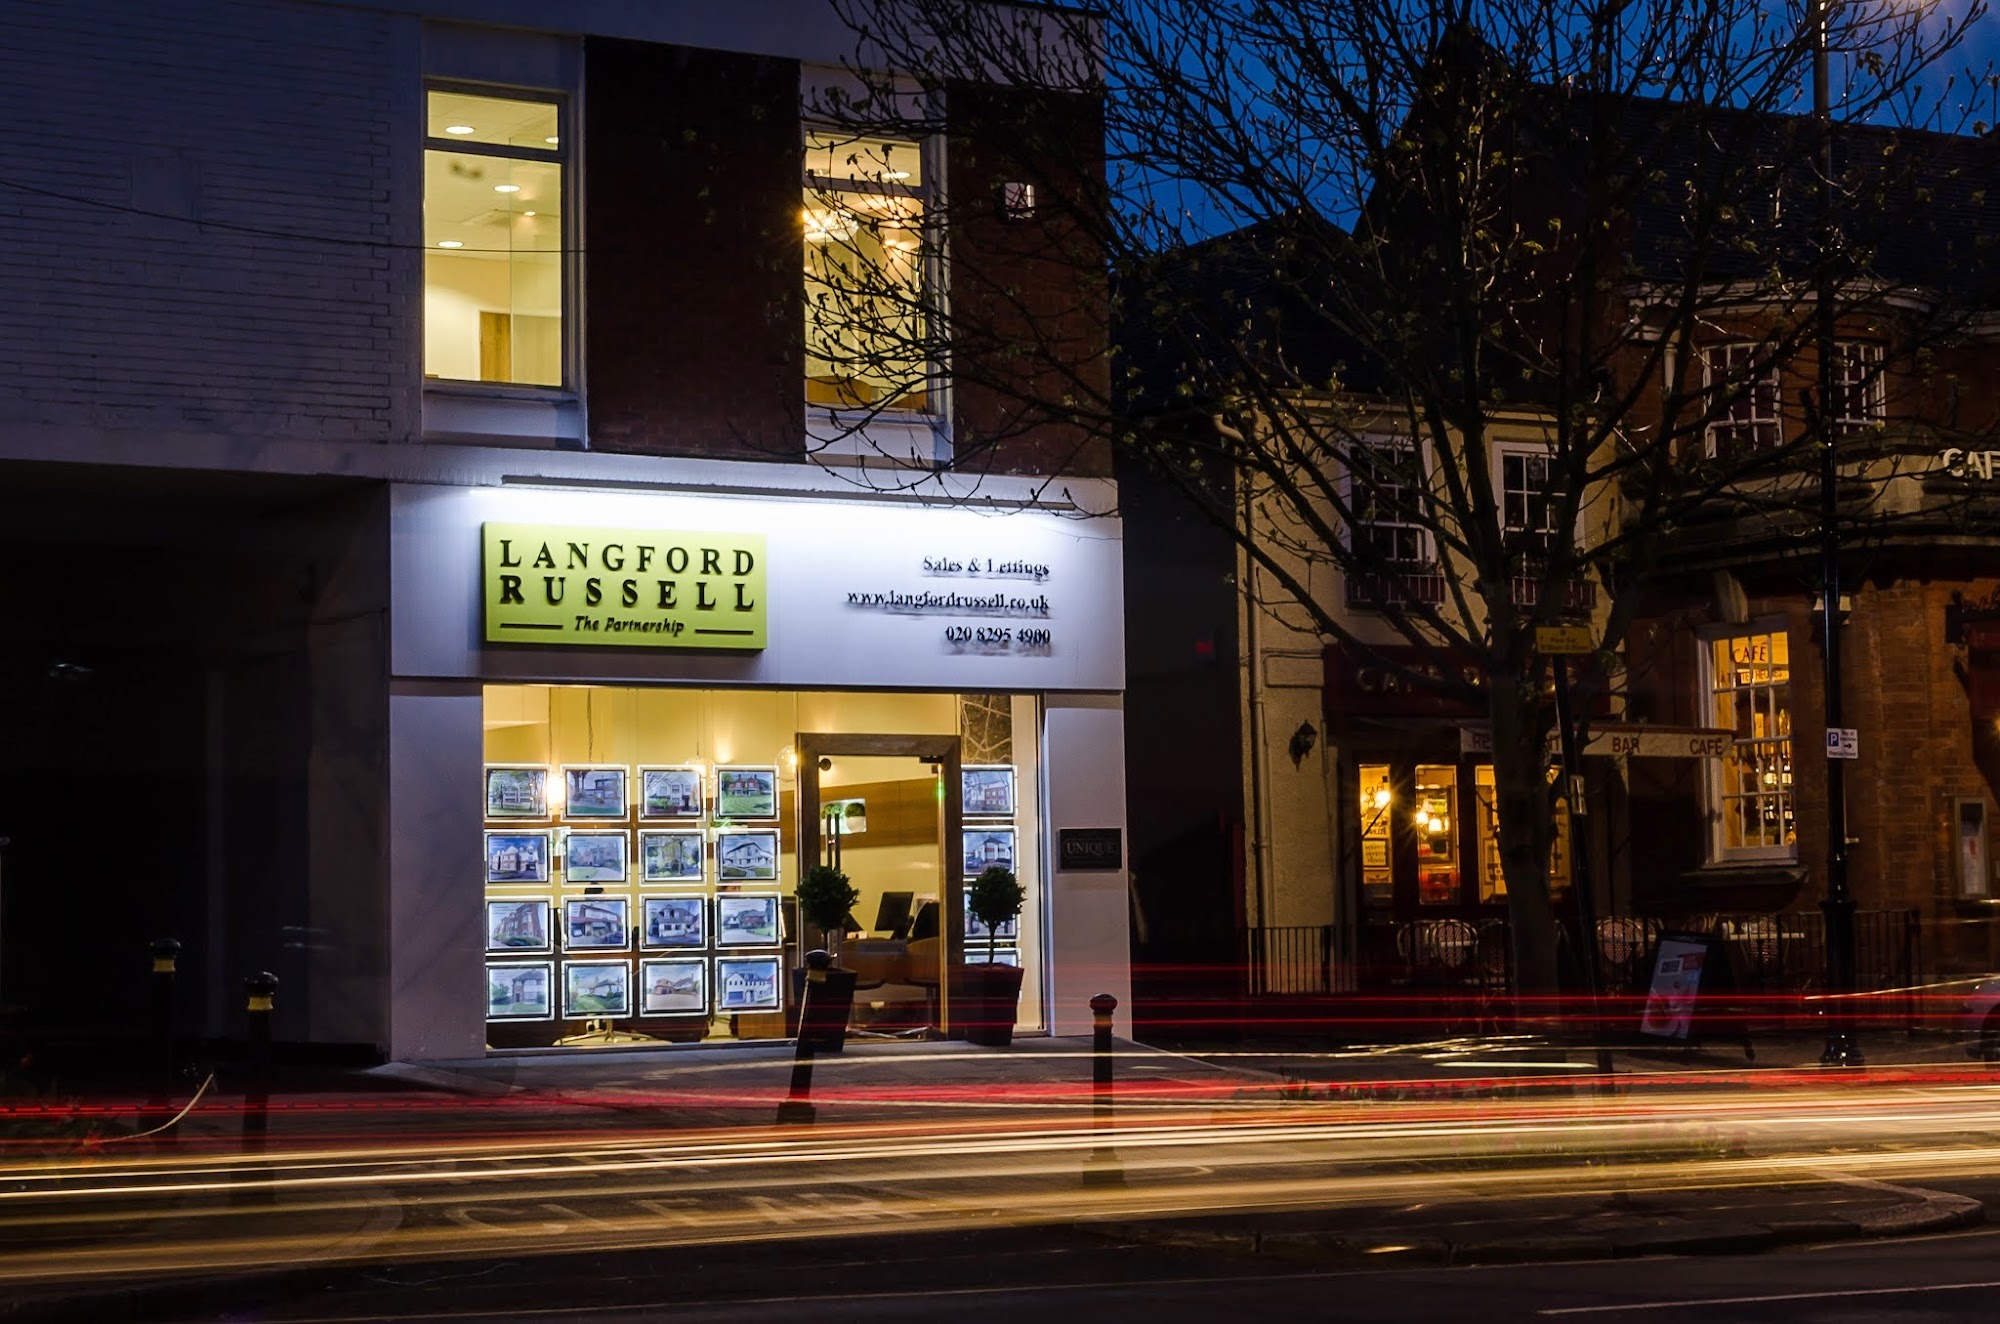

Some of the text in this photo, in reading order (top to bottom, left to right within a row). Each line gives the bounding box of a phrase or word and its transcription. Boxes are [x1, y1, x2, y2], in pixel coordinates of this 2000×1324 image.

[500, 540, 754, 576] LANGFORD
[923, 556, 1050, 579] Sales & Lettings
[500, 575, 754, 612] RUSSELL
[847, 591, 1050, 610] www.langfordrussell.co.uk
[575, 616, 685, 637] The Partnership
[945, 627, 1051, 645] 020 8295 4900
[1612, 737, 1640, 754] BAR
[1066, 841, 1115, 857] UNIQUE
